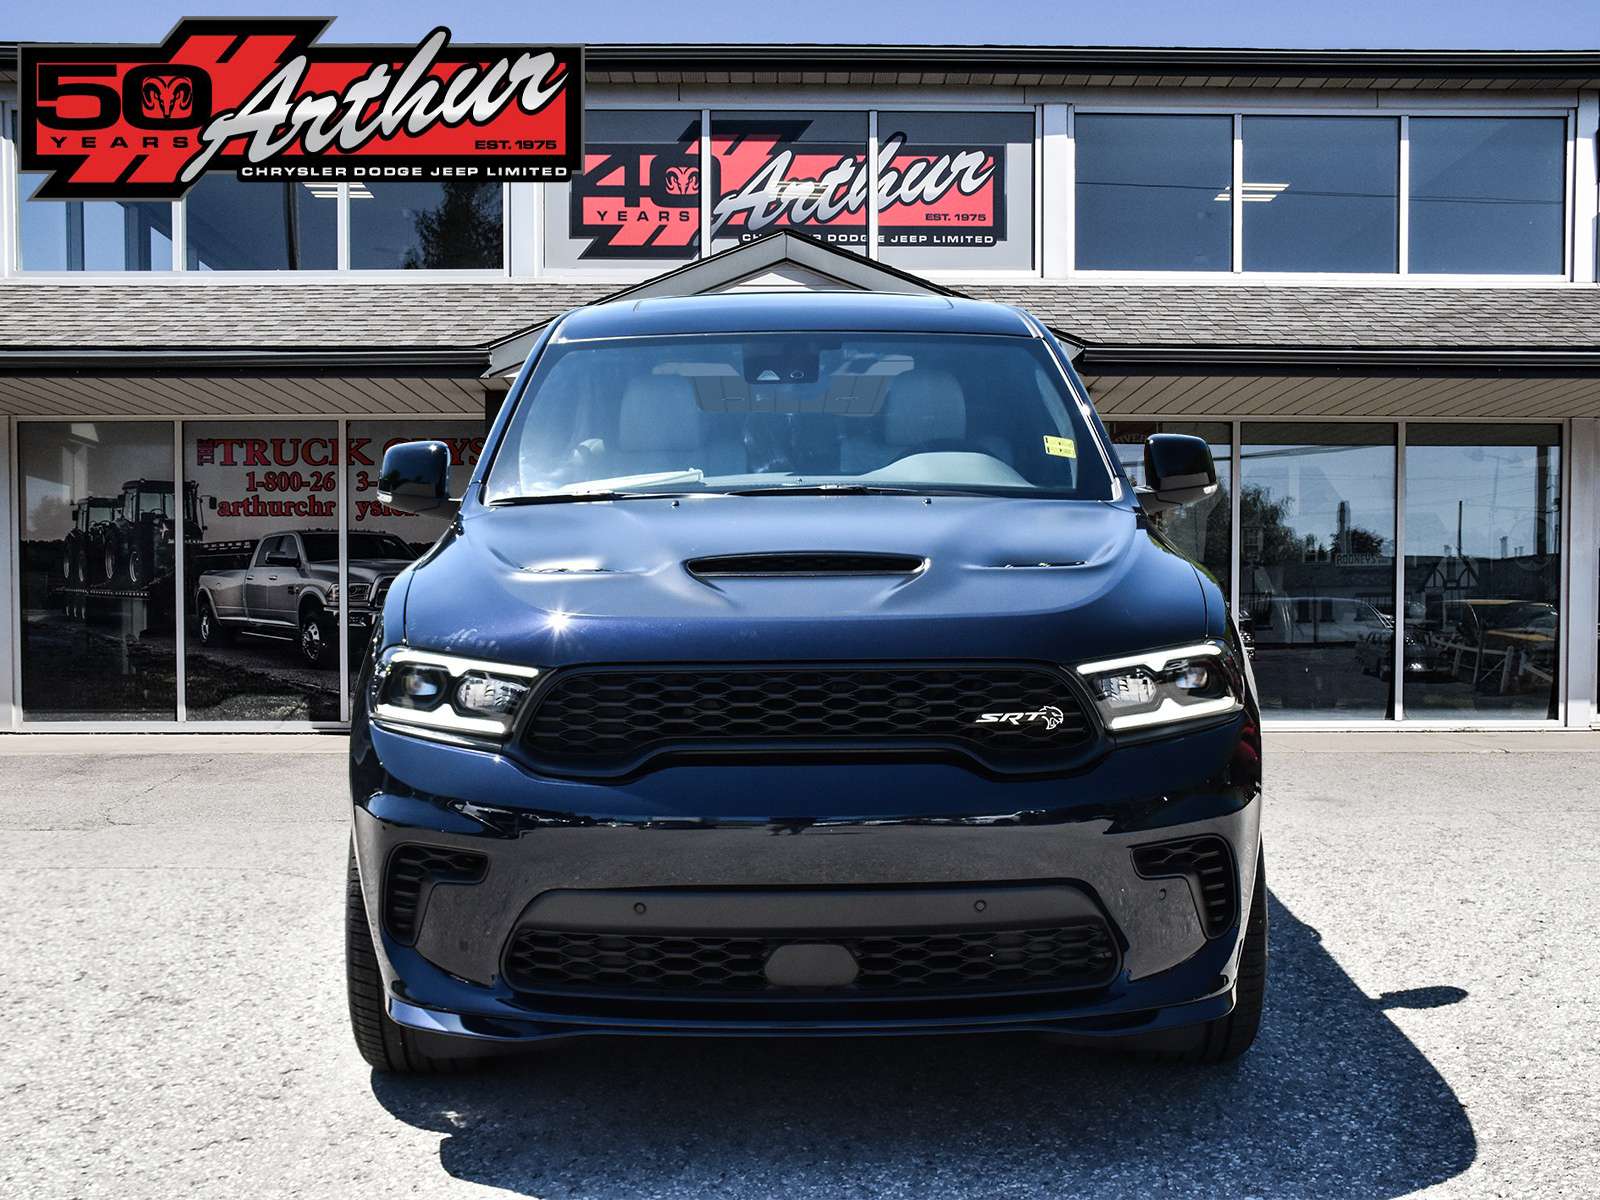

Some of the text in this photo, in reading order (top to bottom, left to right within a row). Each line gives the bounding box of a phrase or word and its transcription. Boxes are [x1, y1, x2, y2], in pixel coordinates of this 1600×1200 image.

[693, 134, 997, 247] Arthur
[596, 210, 690, 222] YEARS
[924, 212, 987, 222] EST. 1975
[890, 234, 928, 244] JEEP
[933, 234, 995, 244] LIMITED
[213, 437, 375, 466] TRUCK
[975, 711, 1047, 726] SRT
